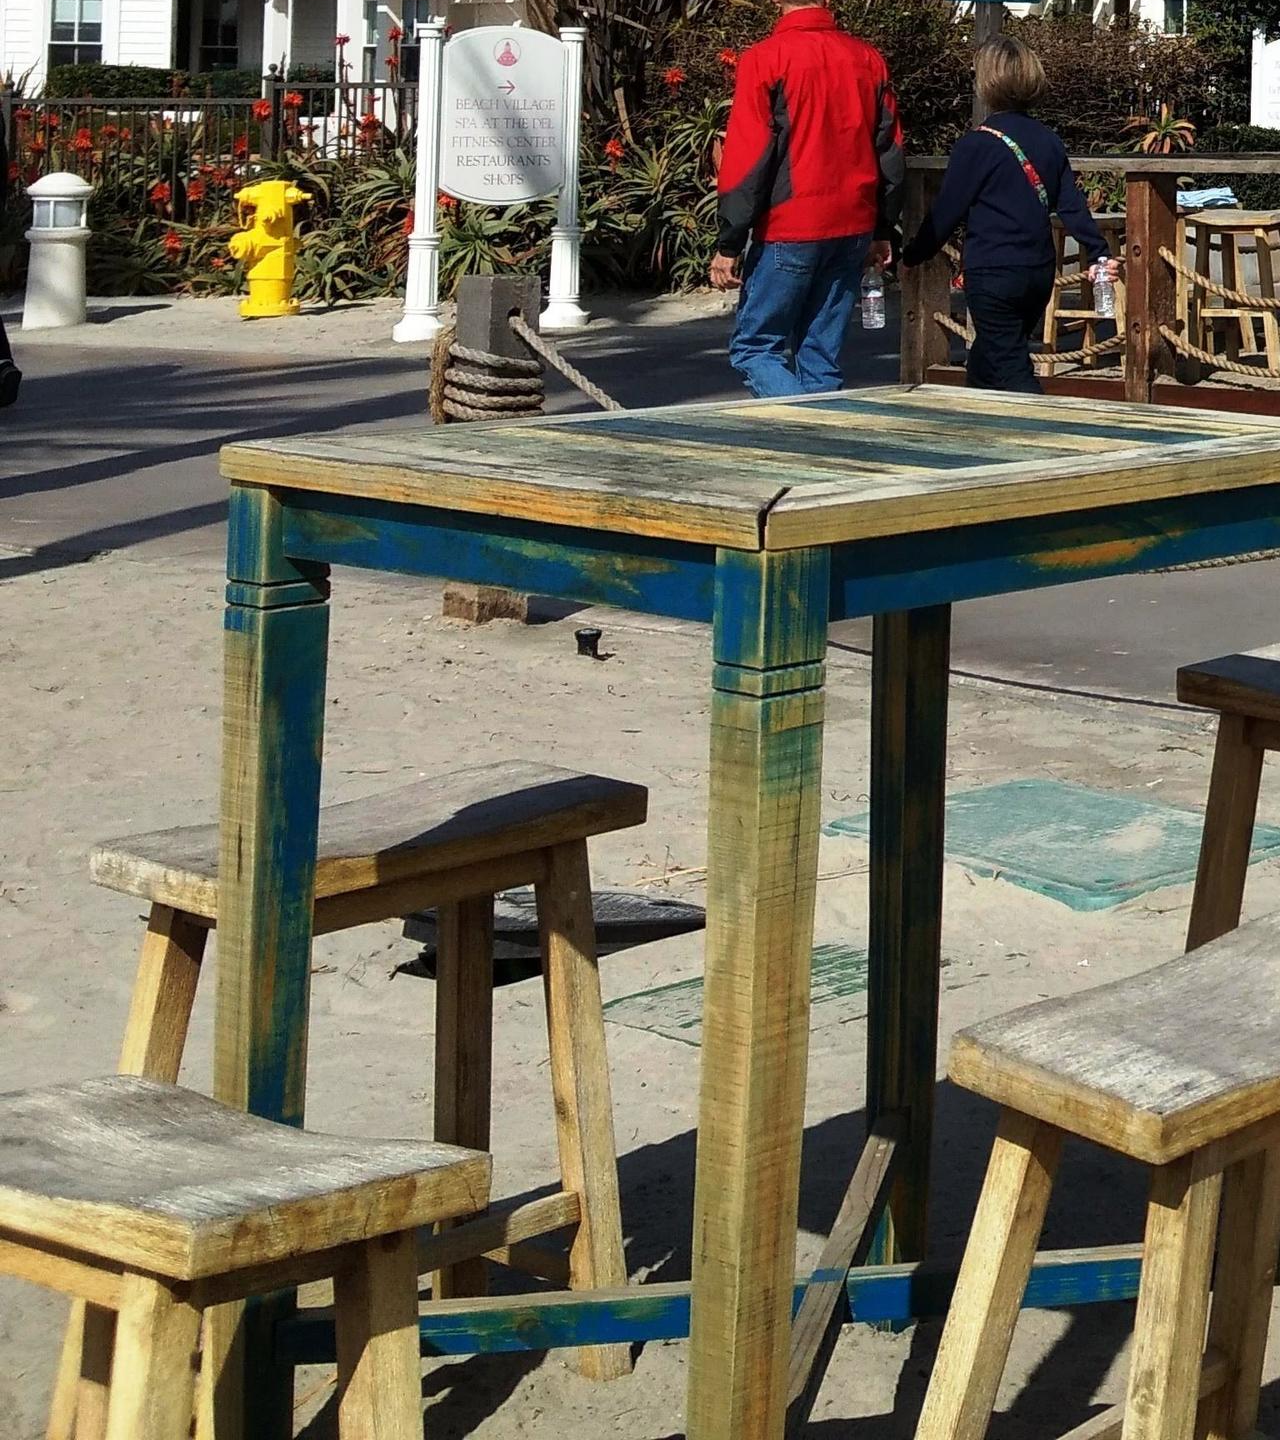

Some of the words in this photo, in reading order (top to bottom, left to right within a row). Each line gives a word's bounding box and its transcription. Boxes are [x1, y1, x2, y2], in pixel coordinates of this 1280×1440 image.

[456, 98, 499, 111] BEACH
[501, 99, 556, 111] VILLAGE
[455, 118, 478, 130] SPA
[482, 118, 501, 130] AT
[503, 118, 529, 130] THE
[532, 118, 555, 130] DEL
[452, 136, 504, 148] FITNESS
[507, 136, 557, 148] CENTER
[456, 155, 551, 167] RESTAURANTS
[483, 173, 525, 185] SHOPS
